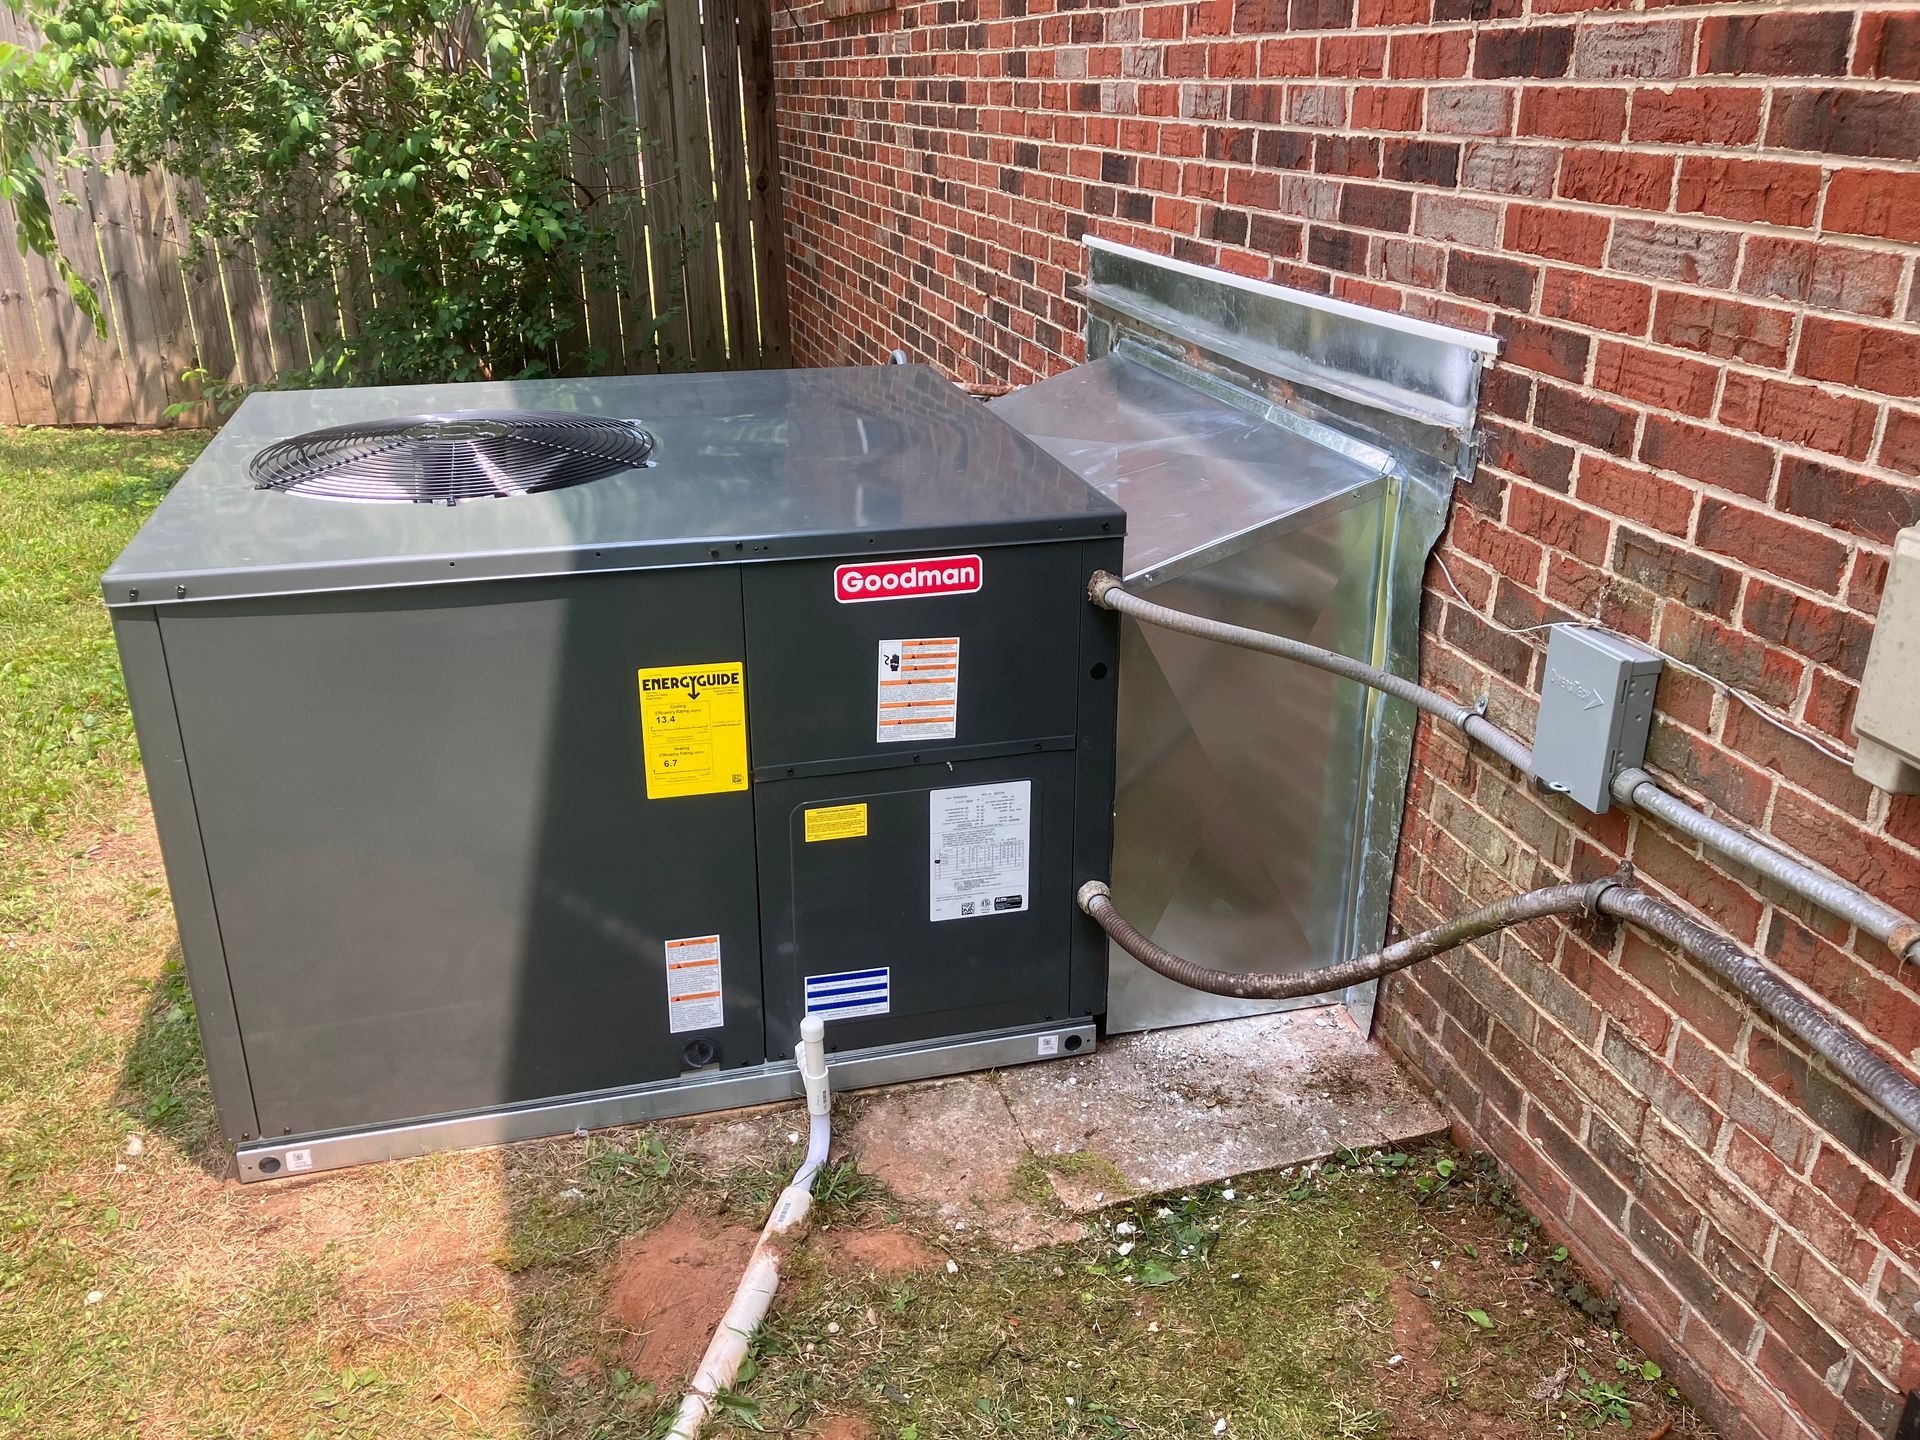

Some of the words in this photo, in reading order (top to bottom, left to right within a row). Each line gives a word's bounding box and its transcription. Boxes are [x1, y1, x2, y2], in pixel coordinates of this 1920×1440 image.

[842, 567, 975, 593] Goodman
[642, 672, 740, 695] ENERGYGUIDE
[656, 716, 676, 724] 13.4
[663, 759, 678, 767] 6.7
